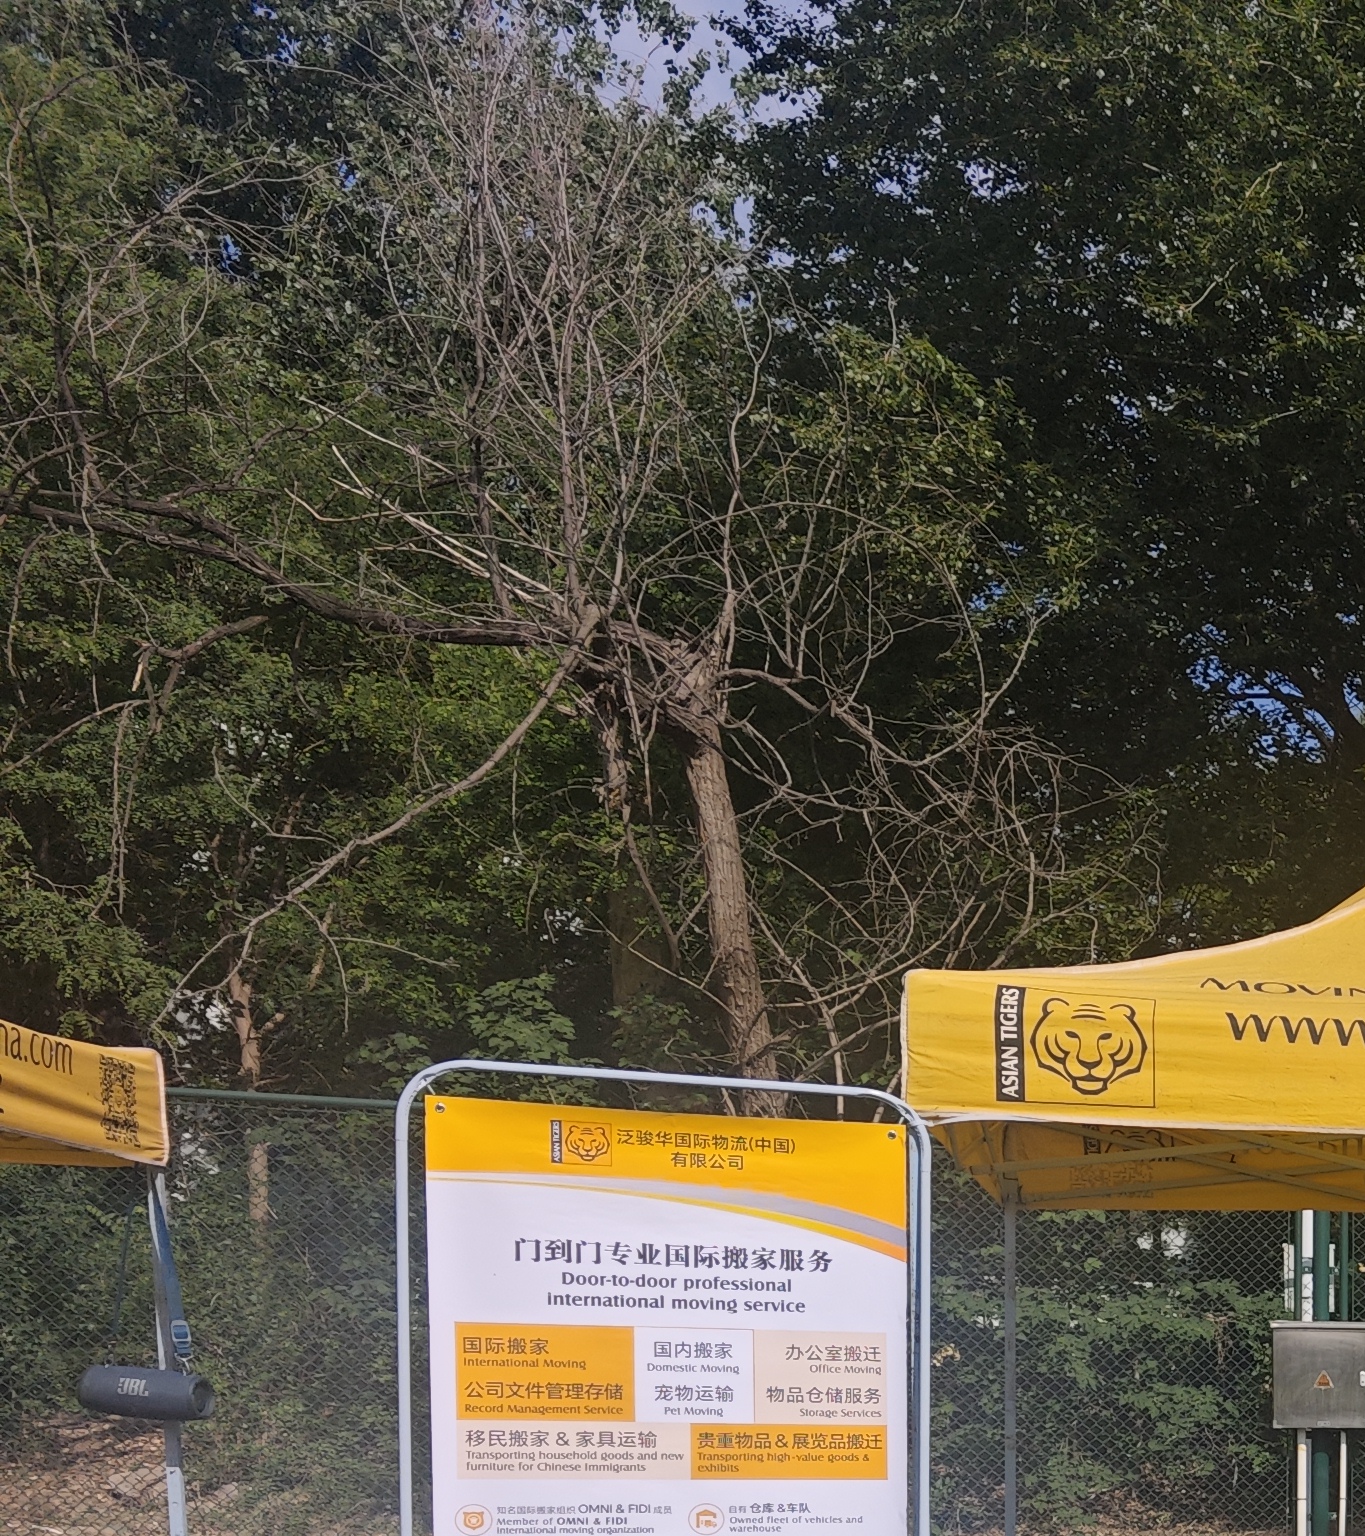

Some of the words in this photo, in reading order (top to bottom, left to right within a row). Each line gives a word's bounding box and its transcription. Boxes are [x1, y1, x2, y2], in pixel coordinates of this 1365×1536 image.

[1000, 987, 1020, 1041] TIGERS
[1001, 1046, 1020, 1098] ASIAN
[616, 1129, 796, 1154] 泛骏华国际物流(中国)
[671, 1151, 744, 1170] 有限公司
[514, 1237, 833, 1273] 门到门专业国际搬家服务
[561, 1271, 677, 1289] Door-to-door
[683, 1277, 792, 1292] professional
[671, 1298, 738, 1314] moving
[744, 1300, 806, 1313] service
[462, 1336, 549, 1355] 国际搬家
[654, 1341, 733, 1359] 国内搬家
[785, 1344, 881, 1362] 办公室搬迁
[463, 1358, 539, 1368] International
[543, 1359, 586, 1370] Moving
[647, 1363, 697, 1373] Domestic
[700, 1364, 740, 1374] Moving
[809, 1364, 841, 1374] Office
[843, 1365, 881, 1375] Moving
[117, 1377, 149, 1397] JBL
[464, 1381, 623, 1400] 公司文件管理存储
[654, 1384, 734, 1402] 宠物运输
[766, 1386, 881, 1405] 物品仓储服务
[464, 1404, 503, 1413] Record
[507, 1404, 581, 1415] Management
[584, 1405, 623, 1415] Service
[664, 1406, 681, 1415] Pet
[684, 1407, 723, 1417] Moving
[800, 1408, 838, 1419] Storage
[841, 1408, 881, 1418] Services
[465, 1430, 549, 1447] 移民搬家
[555, 1431, 570, 1447] &
[576, 1431, 657, 1449] 家具运输
[697, 1432, 772, 1450] 贵重物品
[775, 1434, 788, 1448] &
[792, 1433, 882, 1450] 展览品搬迁
[466, 1451, 535, 1461] Transporting
[539, 1451, 597, 1460] household
[601, 1452, 634, 1462] goods
[637, 1452, 658, 1460] and
[697, 1452, 764, 1463] Transporting
[828, 1453, 859, 1463] goods
[466, 1462, 515, 1471] furniture
[518, 1462, 534, 1471] for
[537, 1462, 581, 1472] Chinese
[698, 1463, 739, 1473] exhibits
[578, 1504, 613, 1514] OMNI
[615, 1504, 625, 1514] &
[628, 1504, 651, 1514] FIDI
[496, 1517, 538, 1526] Member
[543, 1517, 553, 1525] of
[556, 1517, 588, 1526] OMNI
[605, 1517, 628, 1525] FIDI
[729, 1516, 763, 1524] Owned
[559, 1526, 594, 1536] moving
[729, 1525, 782, 1533] warehouse
